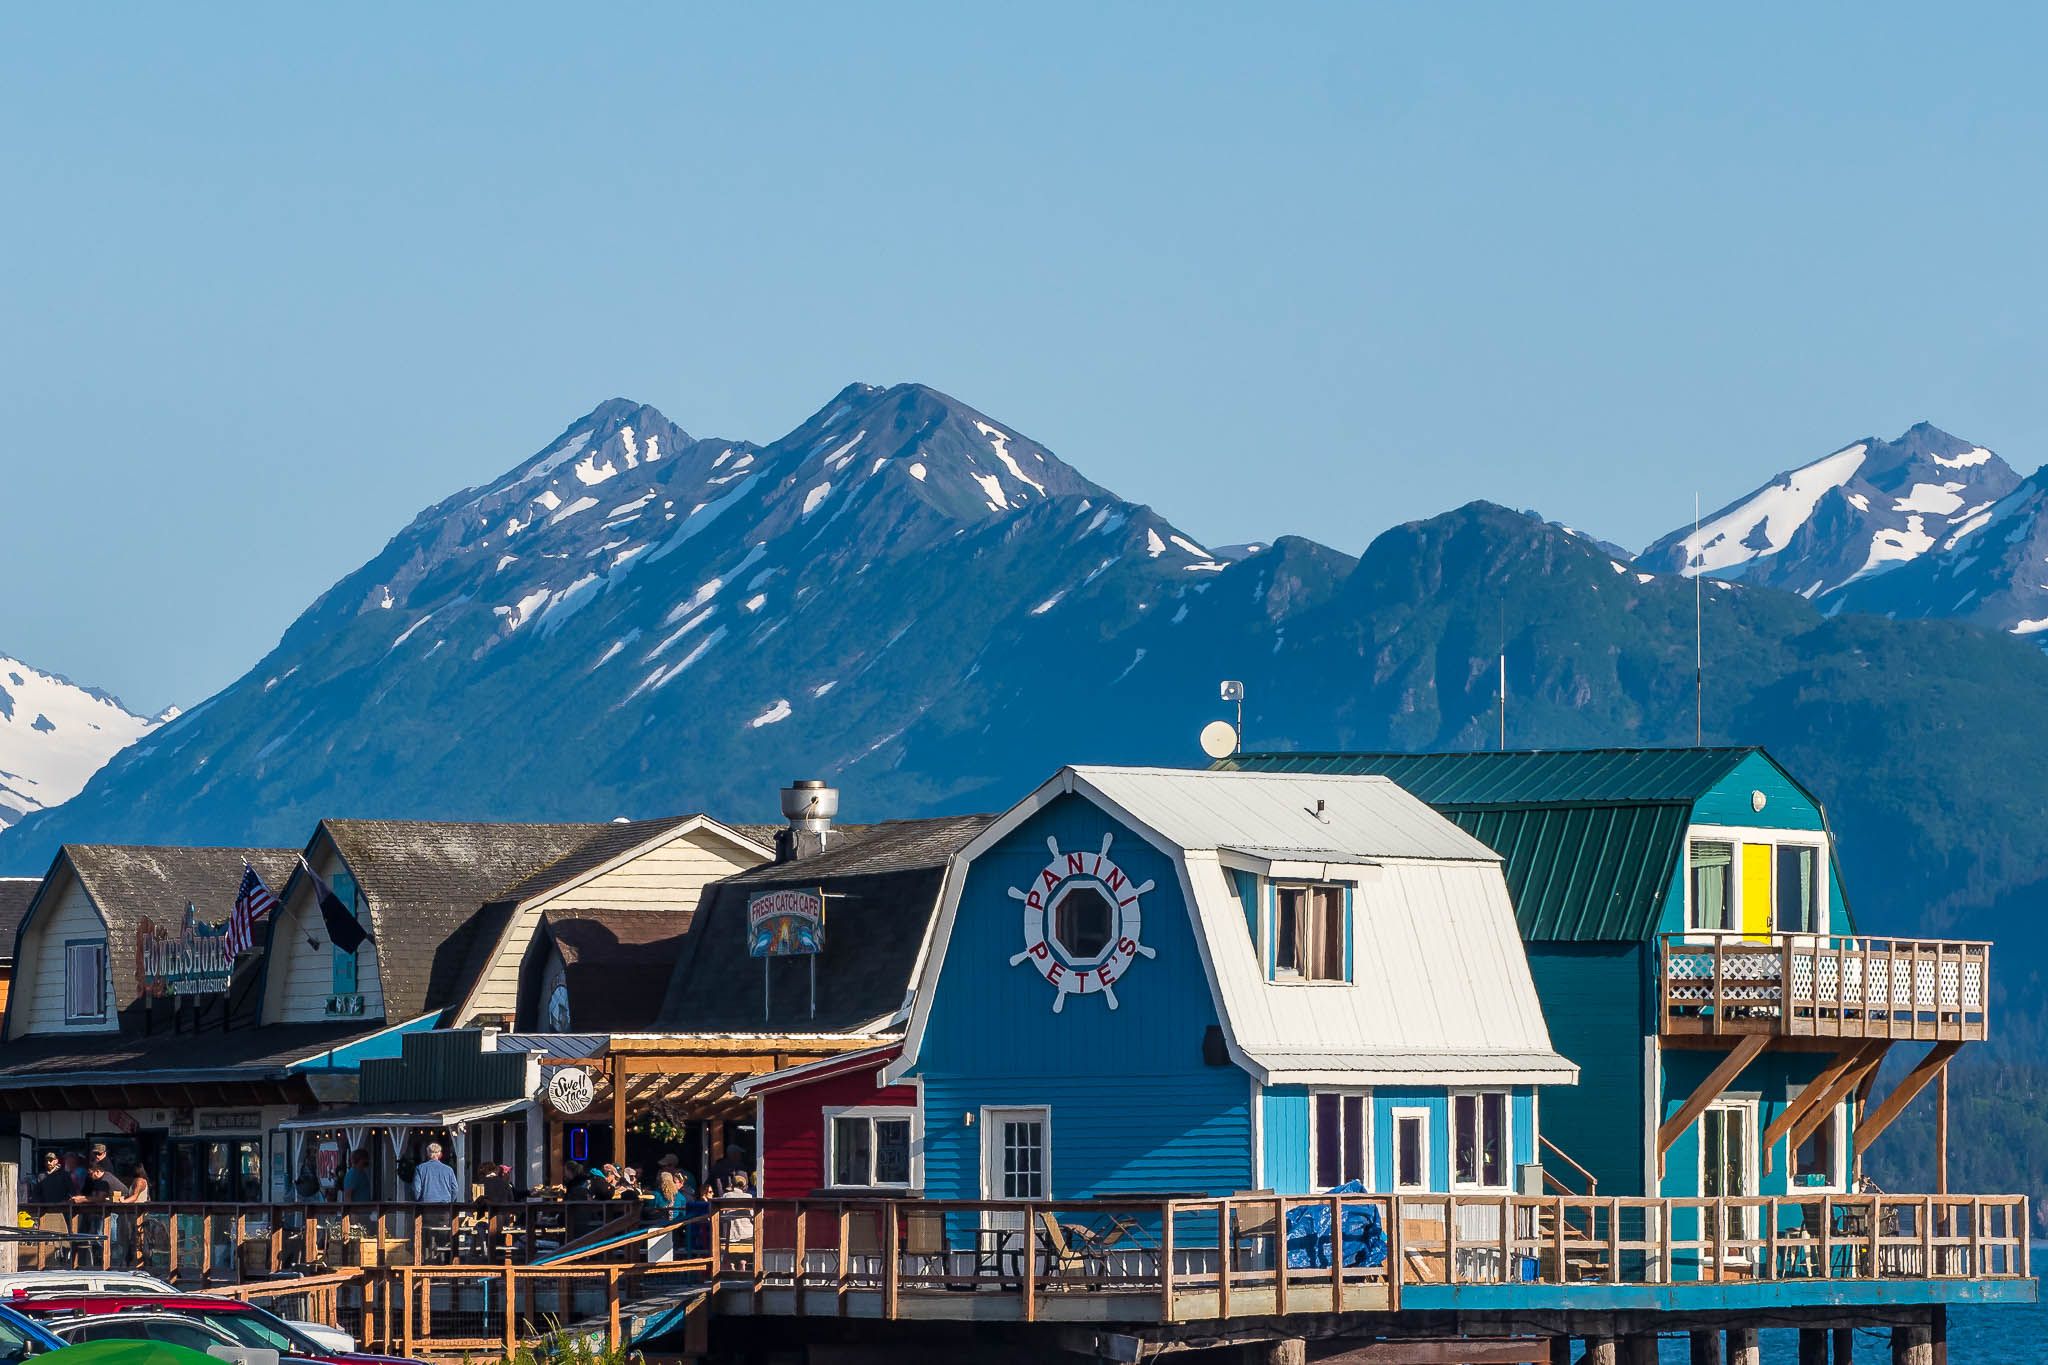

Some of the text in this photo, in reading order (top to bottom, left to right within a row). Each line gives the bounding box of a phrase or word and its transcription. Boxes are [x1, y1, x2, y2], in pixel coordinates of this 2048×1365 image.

[1026, 852, 1137, 912] PANINI
[752, 893, 819, 921] FRESH CATCH CAFE
[142, 928, 235, 977] HOMER SHORE
[1028, 936, 1137, 993] PETE'S
[554, 1074, 586, 1098] Swell
